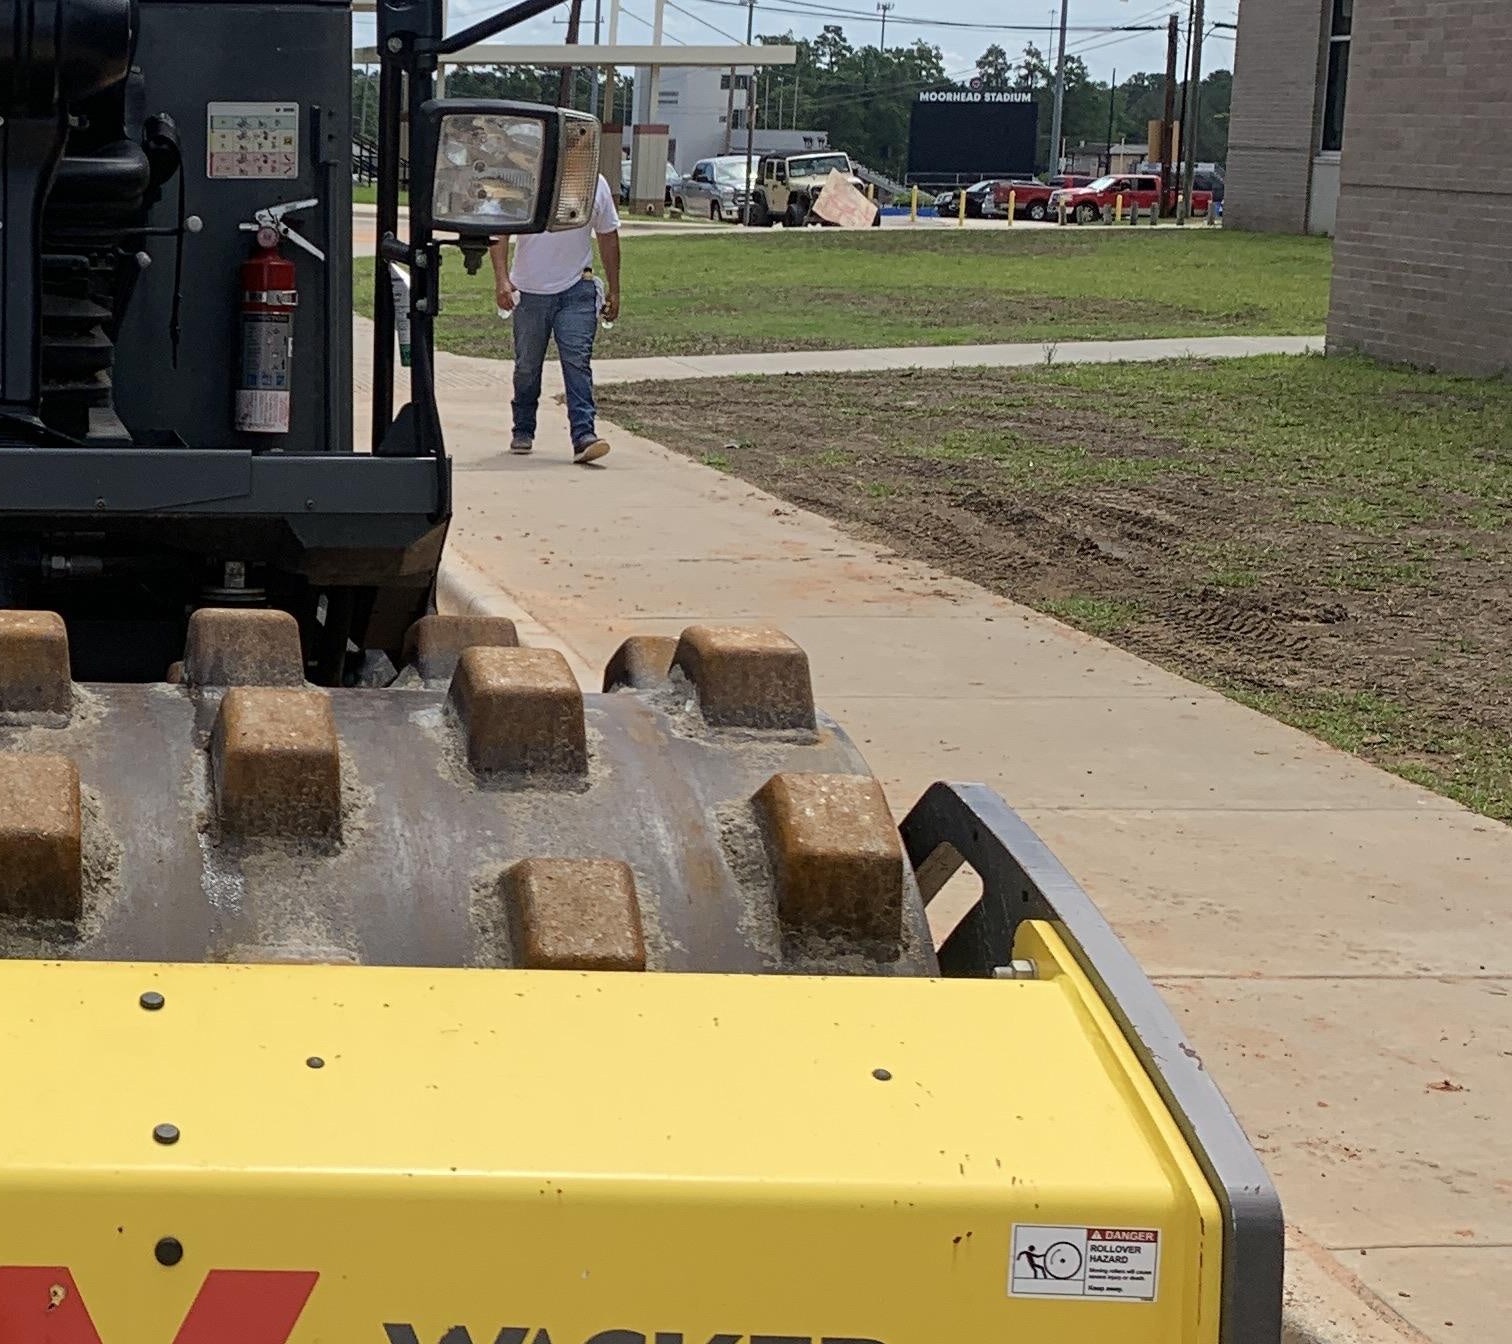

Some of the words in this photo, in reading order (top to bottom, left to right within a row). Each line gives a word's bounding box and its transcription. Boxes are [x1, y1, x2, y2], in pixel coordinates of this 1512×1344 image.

[919, 92, 981, 102] MOORHEAD
[984, 92, 1032, 103] STADIUM
[1105, 1231, 1154, 1241] DANGER
[1090, 1245, 1142, 1254] ROLLOVER
[1089, 1255, 1128, 1264] HAZARD
